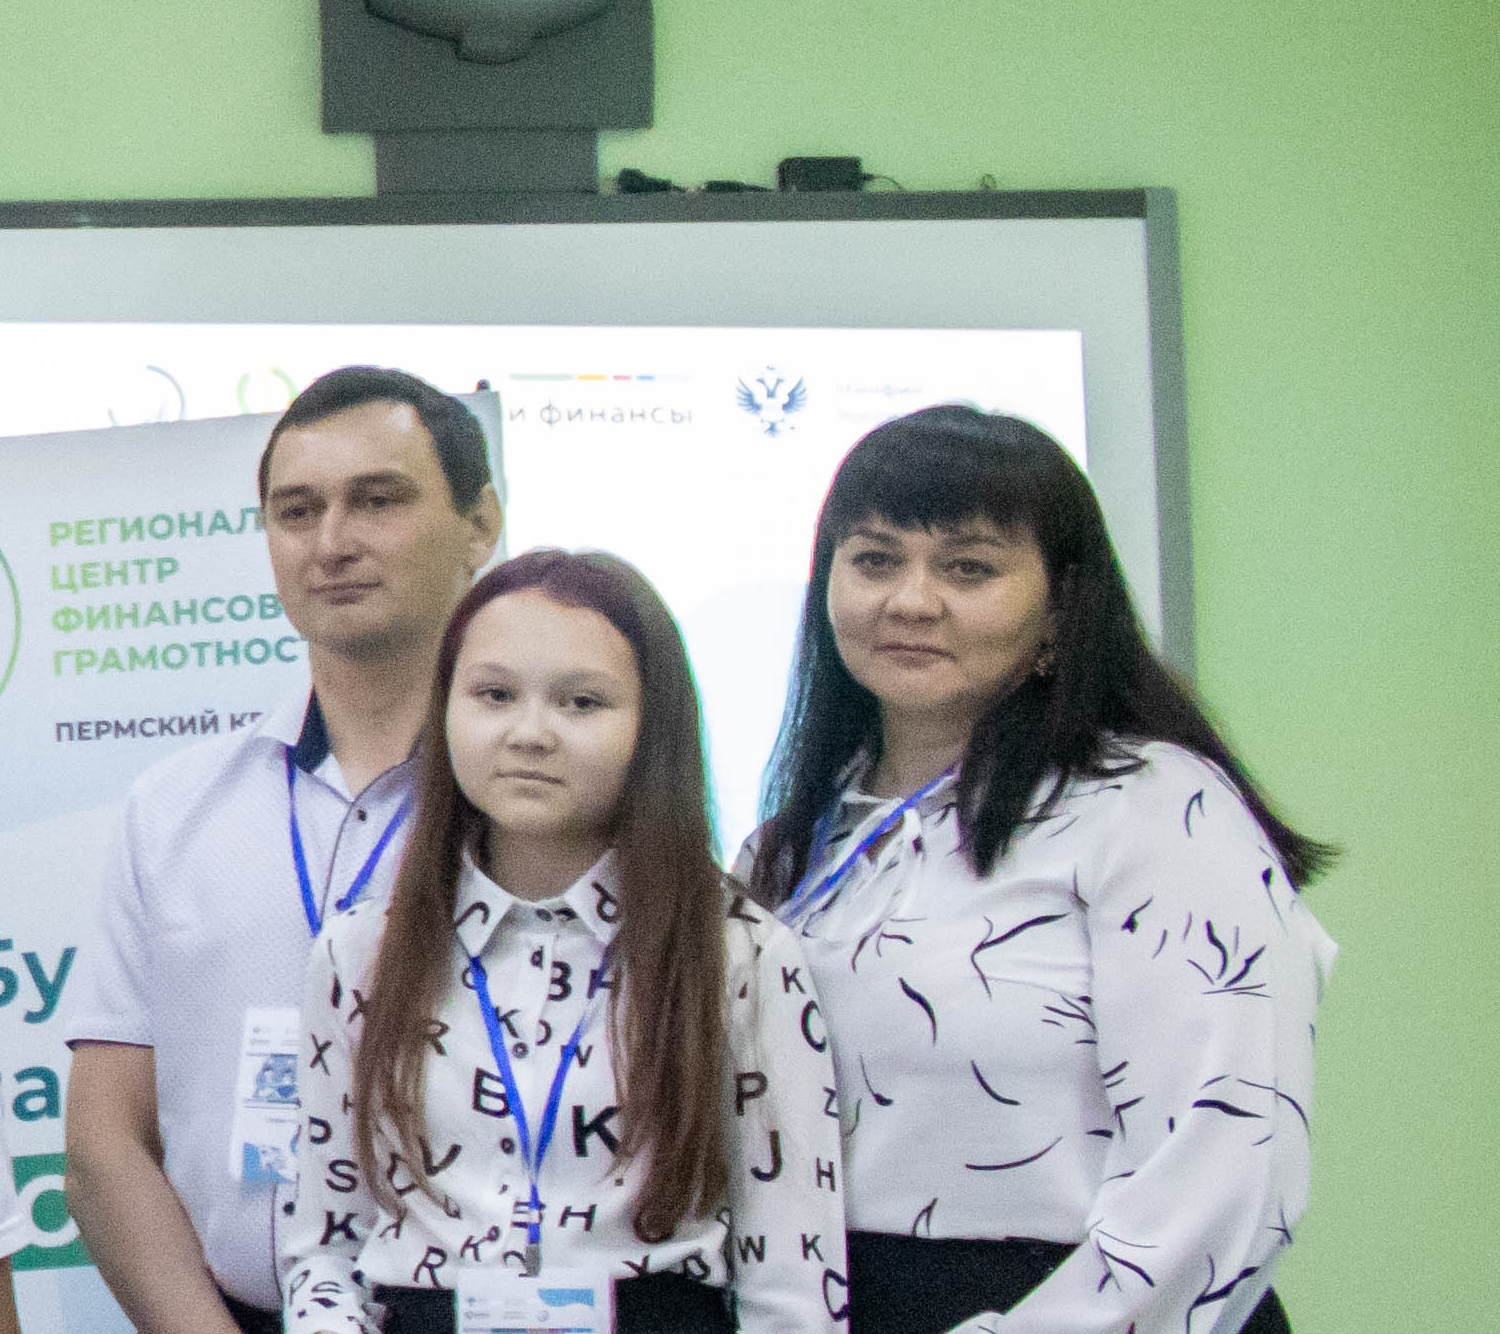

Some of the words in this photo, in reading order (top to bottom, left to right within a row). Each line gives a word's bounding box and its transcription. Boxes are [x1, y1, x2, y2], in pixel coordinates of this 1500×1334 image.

[540, 401, 693, 430] финансы
[50, 506, 264, 548] РЕГИОНАЛ
[52, 557, 180, 593] ЦЕНТР
[52, 593, 284, 633] ФИНАНСОВ
[53, 636, 300, 677] ГРАМОТНОС
[56, 709, 220, 742] ПЕРМСКИЙ
[734, 1071, 769, 1117] P
[573, 1104, 623, 1158] K
[325, 1158, 359, 1193] S
